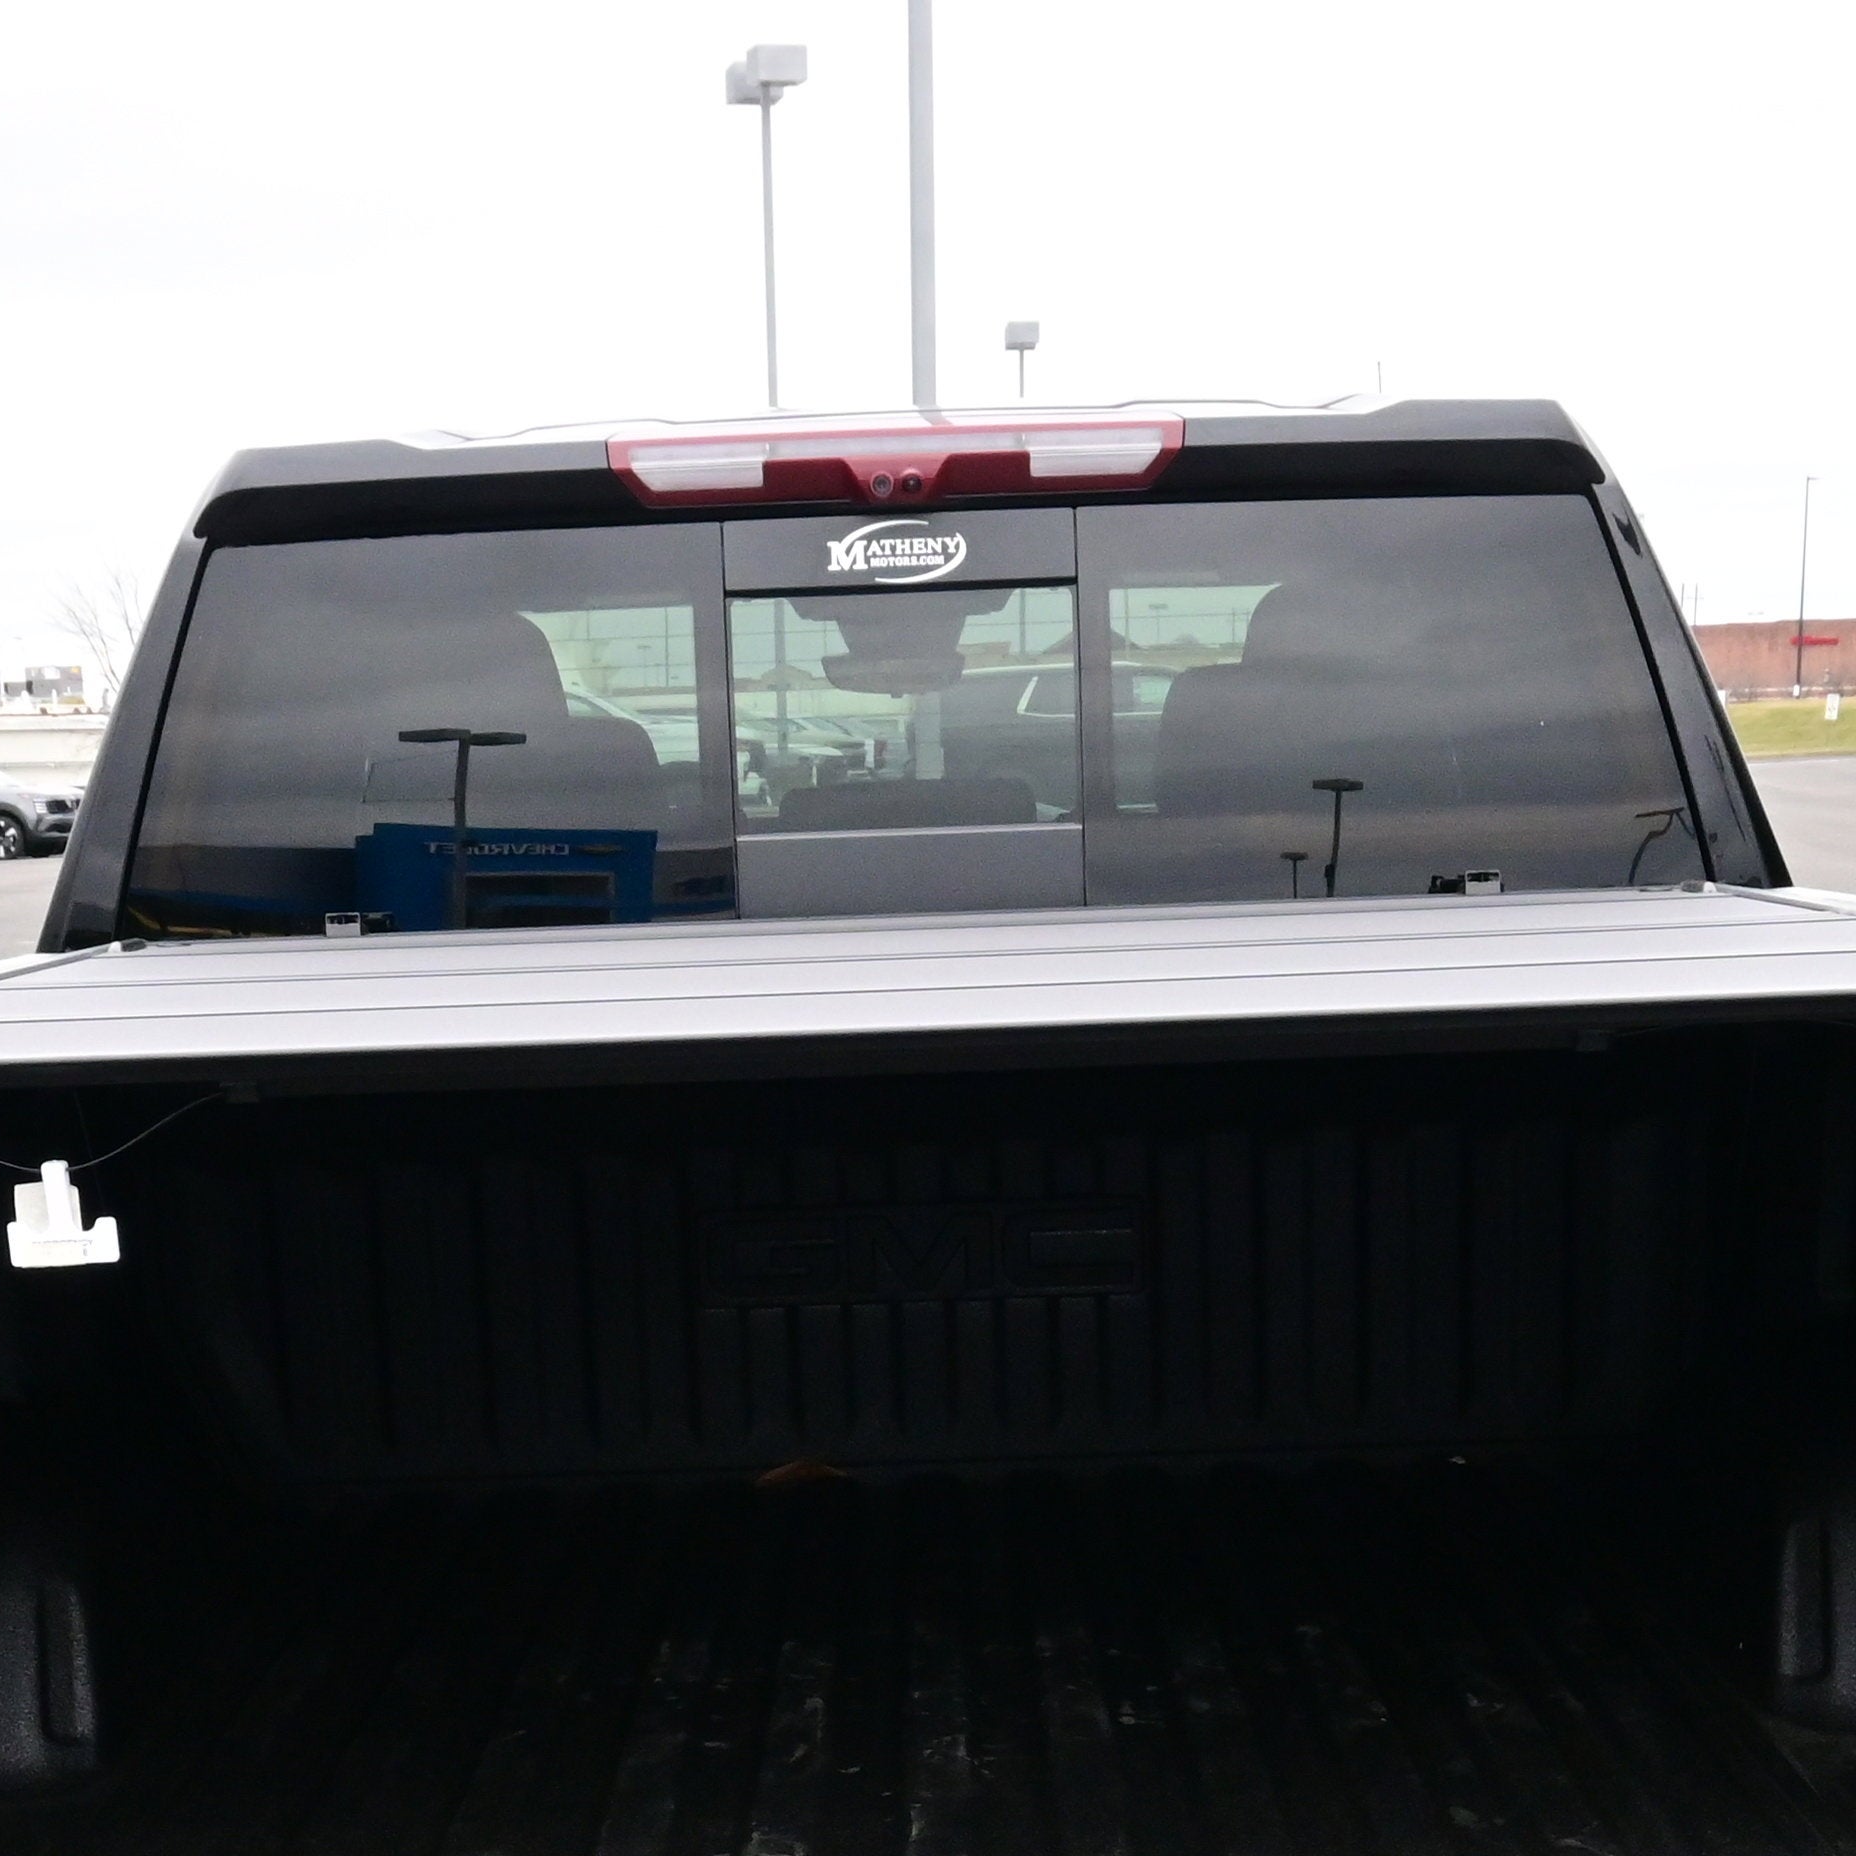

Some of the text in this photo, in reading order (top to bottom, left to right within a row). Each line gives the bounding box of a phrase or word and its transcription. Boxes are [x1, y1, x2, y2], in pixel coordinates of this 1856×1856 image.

[827, 536, 961, 571] MATHENY
[869, 554, 945, 567] MOTORS.COM
[702, 1204, 1138, 1303] GMC
